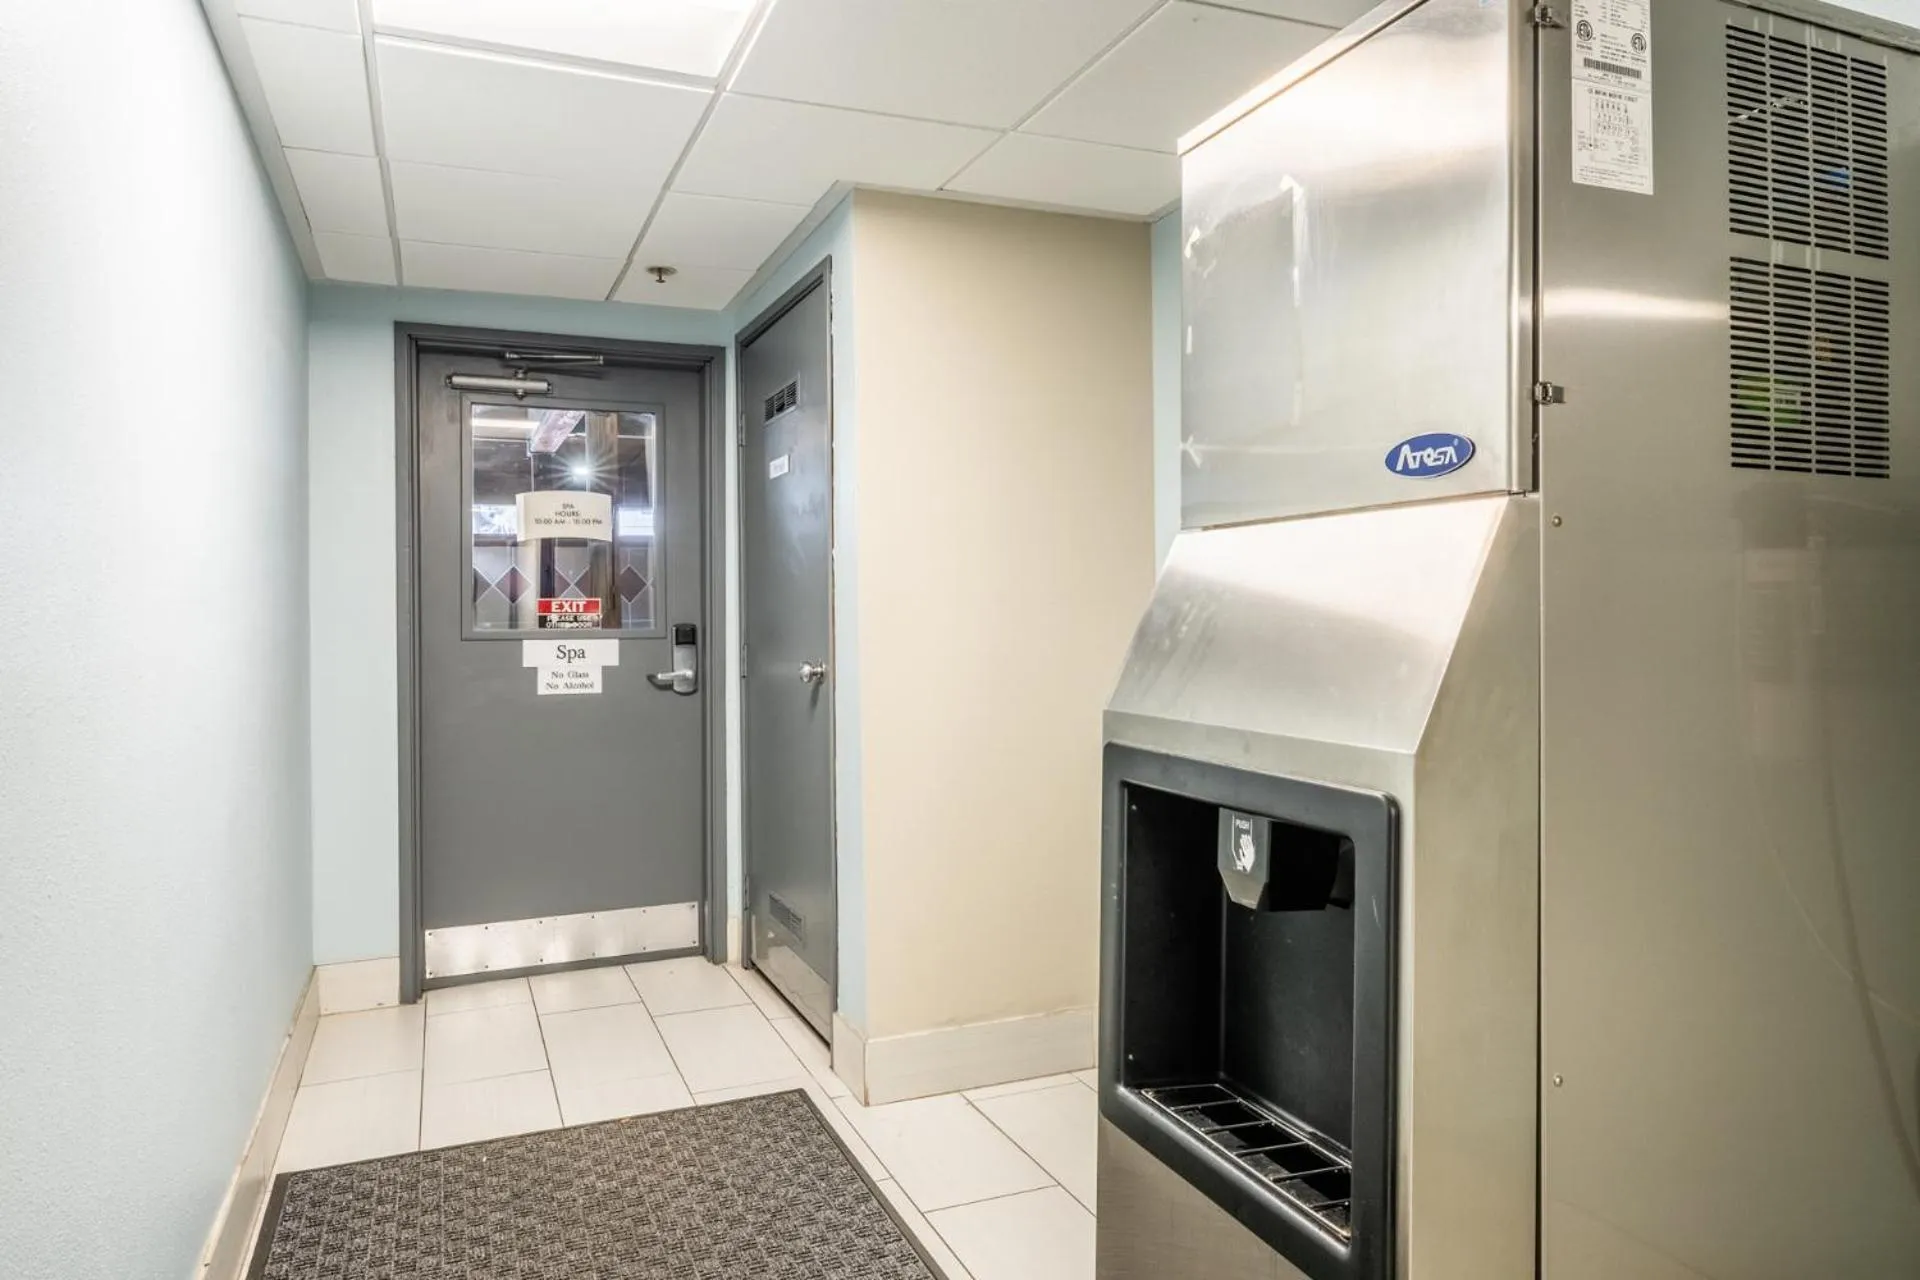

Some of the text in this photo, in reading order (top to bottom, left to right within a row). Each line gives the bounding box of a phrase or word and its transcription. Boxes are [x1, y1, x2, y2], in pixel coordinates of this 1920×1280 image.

[592, 518, 603, 526] PM
[551, 601, 587, 613] EXIT
[556, 644, 586, 664] Spa
[551, 670, 590, 679] No Glass
[546, 681, 595, 690] No Alcohol
